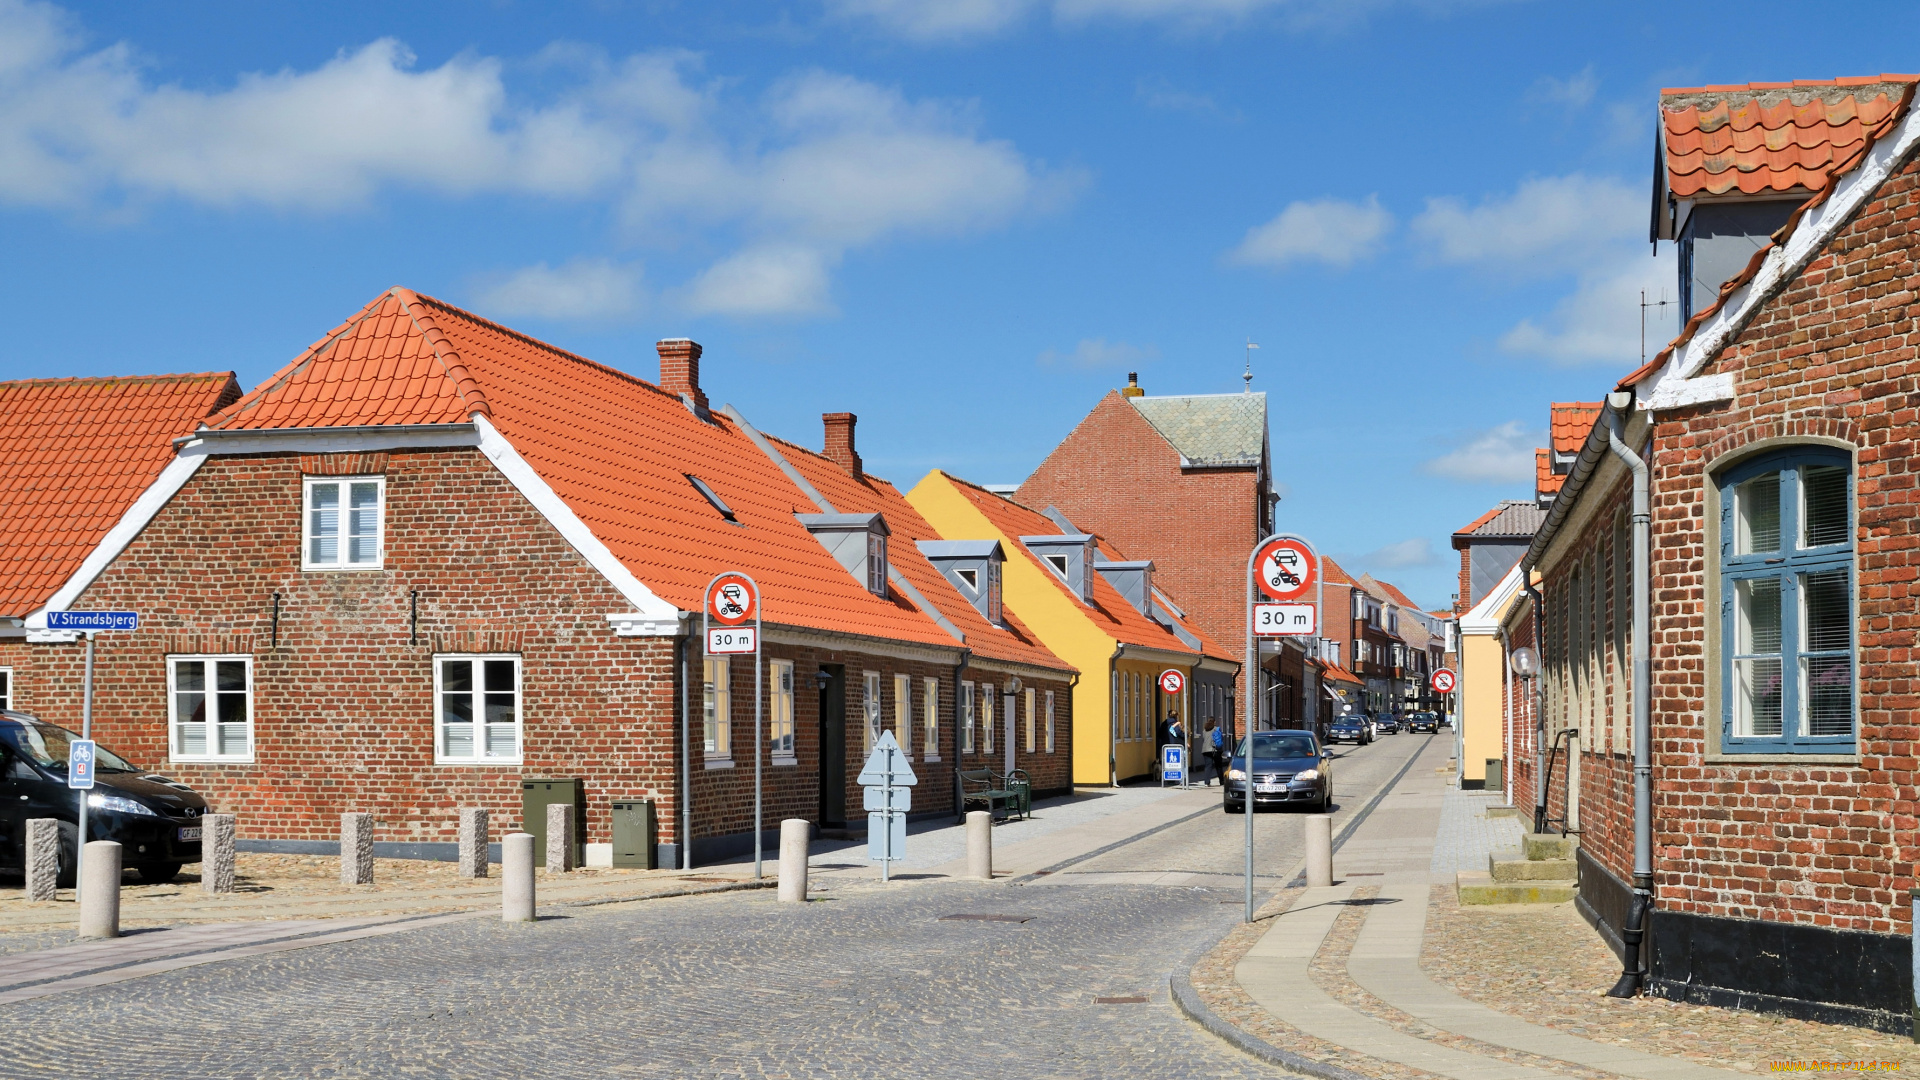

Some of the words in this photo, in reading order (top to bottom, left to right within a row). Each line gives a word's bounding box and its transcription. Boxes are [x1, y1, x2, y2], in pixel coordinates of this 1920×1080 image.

[49, 613, 59, 625] V.
[61, 613, 136, 629] Strandsbjerg
[1262, 612, 1285, 625] 30
[1293, 615, 1307, 625] m
[715, 634, 733, 646] 30
[738, 636, 749, 645] m
[182, 829, 190, 838] GF
[191, 828, 198, 838] 22
